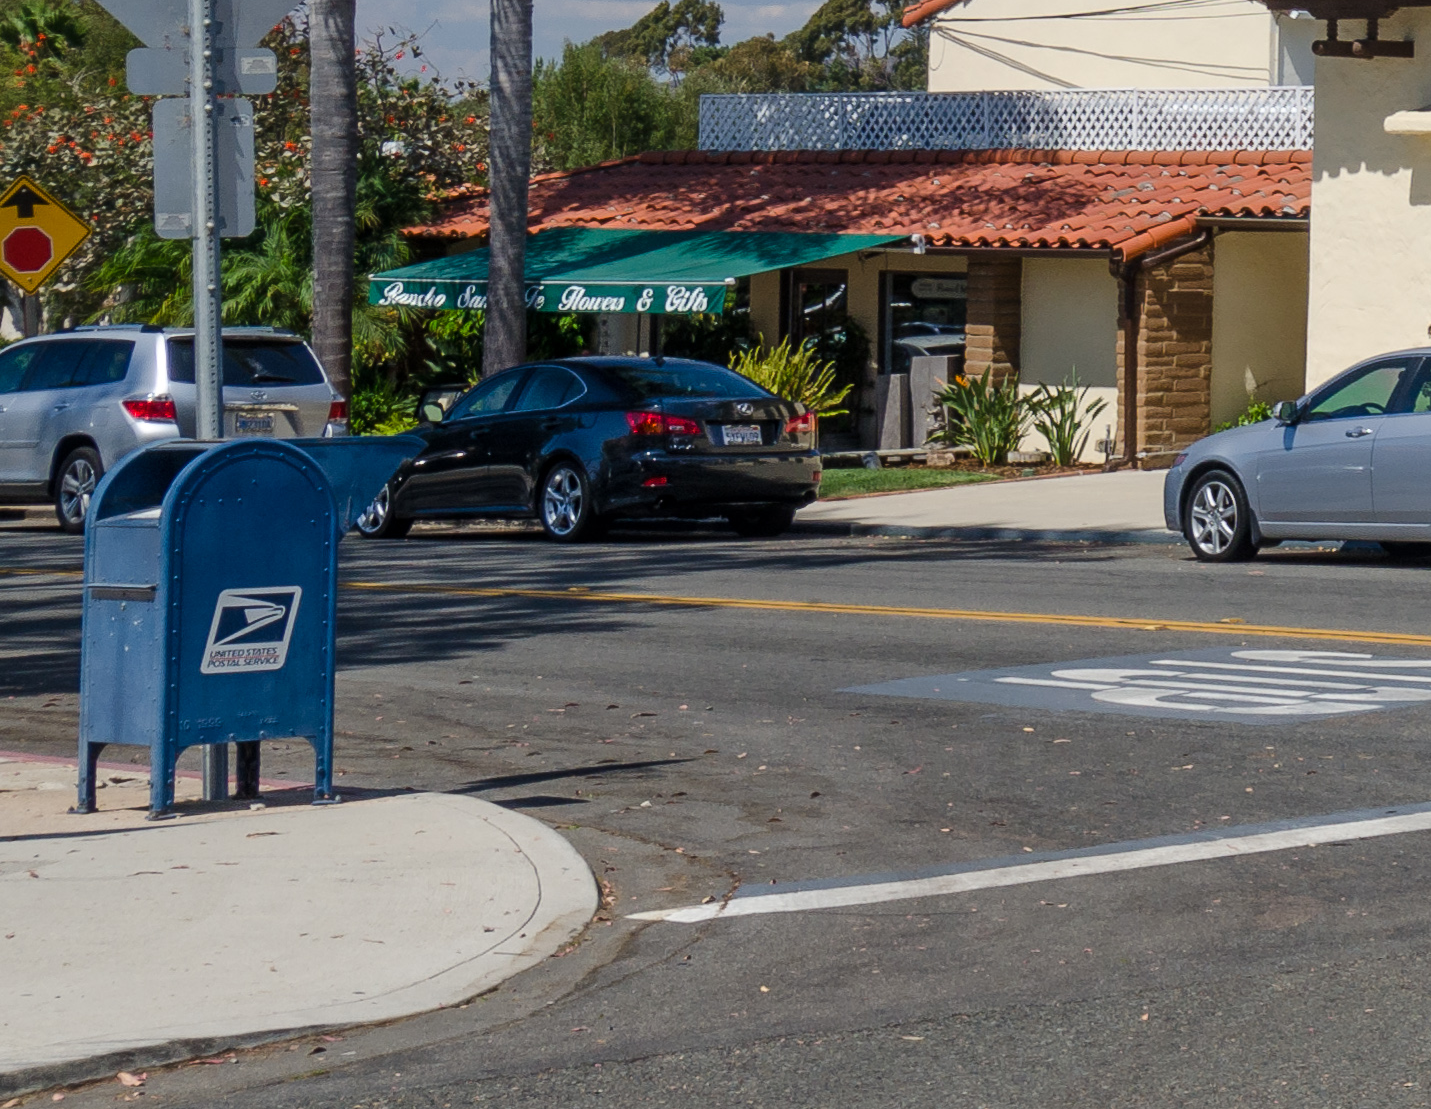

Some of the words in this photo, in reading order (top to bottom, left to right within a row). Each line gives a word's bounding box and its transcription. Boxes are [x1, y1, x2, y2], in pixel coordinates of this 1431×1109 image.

[378, 281, 447, 307] Rancho
[558, 285, 626, 311] Flowers
[635, 288, 654, 311] &
[664, 285, 709, 313] Gifts
[210, 648, 245, 658] UNITED
[246, 646, 278, 656] STATES
[207, 659, 241, 669] POSTAL
[243, 657, 279, 667] SERVICE
